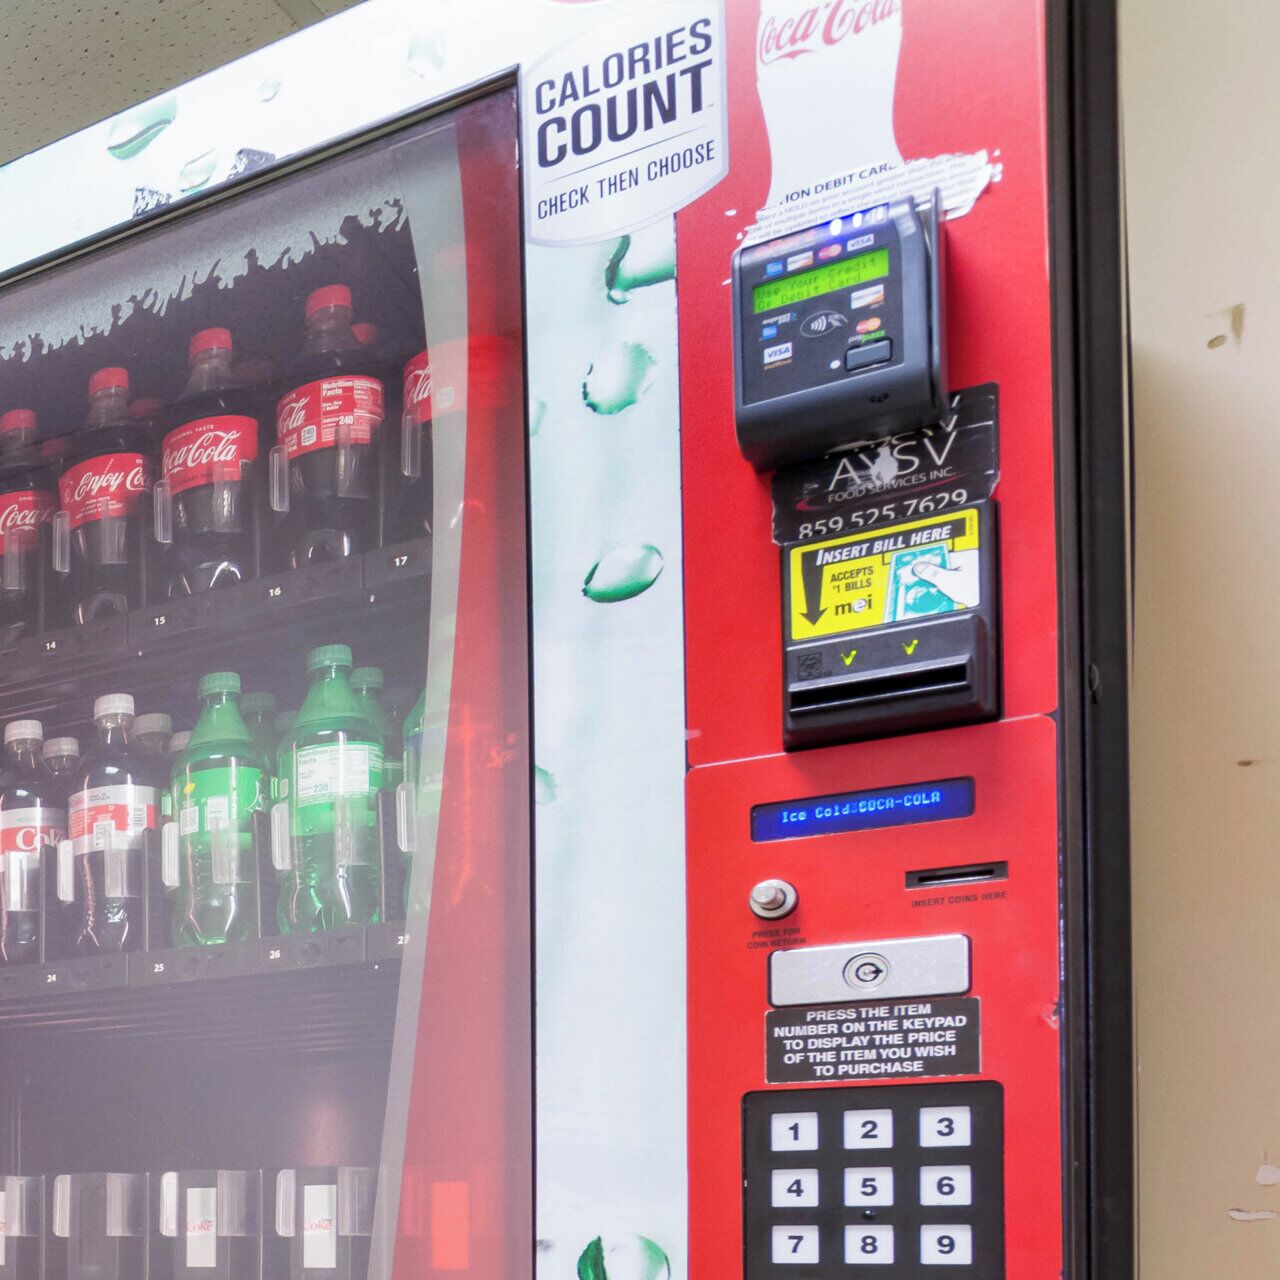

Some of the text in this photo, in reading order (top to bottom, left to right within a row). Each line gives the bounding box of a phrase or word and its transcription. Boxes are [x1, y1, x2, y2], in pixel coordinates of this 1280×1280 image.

[535, 17, 713, 116] CALORIES
[537, 57, 713, 169] COUNT
[538, 139, 716, 220] CHECK THEN CHOOSE
[814, 162, 897, 195] DEBIT CAR
[757, 255, 878, 300] Use Your Credit
[828, 271, 863, 289] Card
[766, 345, 791, 360] VISA
[338, 415, 355, 426] 240
[829, 430, 959, 492] ASV
[74, 470, 125, 502] Enjoy
[828, 486, 868, 504] FOOD
[816, 525, 953, 567] INSERT BILL HERE
[394, 555, 408, 567] 17
[830, 565, 875, 584] ACCEPTS
[269, 587, 282, 597] 16
[844, 577, 873, 592] BILLS
[834, 593, 874, 617] mei
[154, 616, 166, 626] 15
[46, 641, 57, 650] 14
[782, 791, 942, 824] Ice Cold COCA-COLA
[911, 890, 1008, 909] INSERT COINS HERE
[752, 926, 802, 939] PRESS FOR
[747, 936, 807, 950] COIN RETURN
[269, 949, 281, 960] 26
[153, 963, 165, 973] 25
[46, 973, 57, 983] 24
[806, 1003, 932, 1023] PRESS THE ITEM
[773, 1014, 968, 1039] NUMBER ON THE KEYPAD
[783, 1029, 957, 1052] TO DISPLAY THE PRICE
[783, 1044, 957, 1065] OF THE ITEM YOU WISH
[814, 1059, 925, 1077] TO PURCHASE
[787, 1116, 955, 1142] 1 2 3
[786, 1175, 956, 1198] 4 5 6
[787, 1234, 956, 1256] 7 8 9
